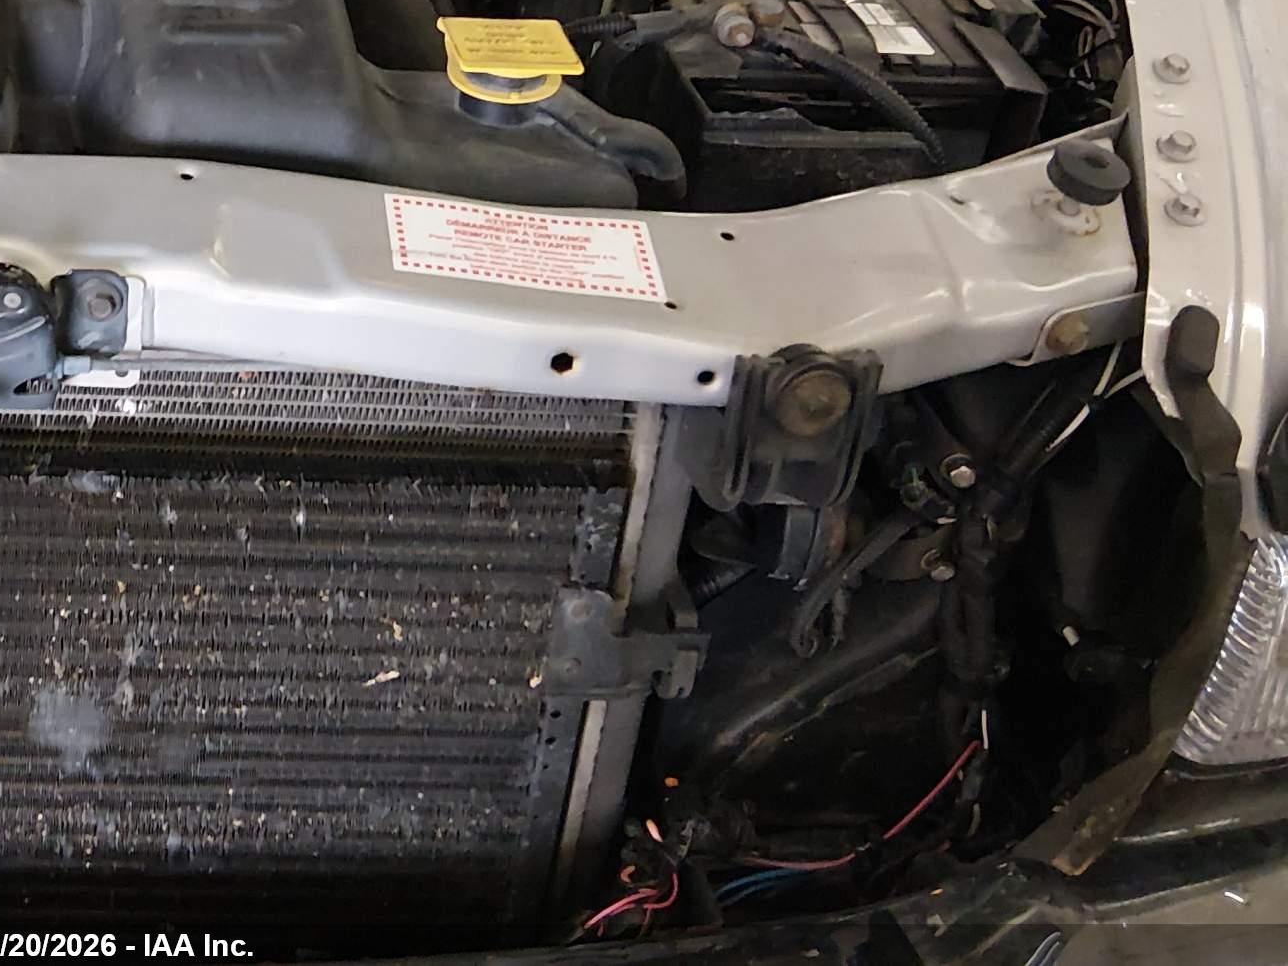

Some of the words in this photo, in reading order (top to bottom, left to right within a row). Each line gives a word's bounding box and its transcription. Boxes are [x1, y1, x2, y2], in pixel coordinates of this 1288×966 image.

[454, 228, 502, 241] REMOTE
[506, 236, 530, 245] CAR
[533, 238, 587, 251] STARTER
